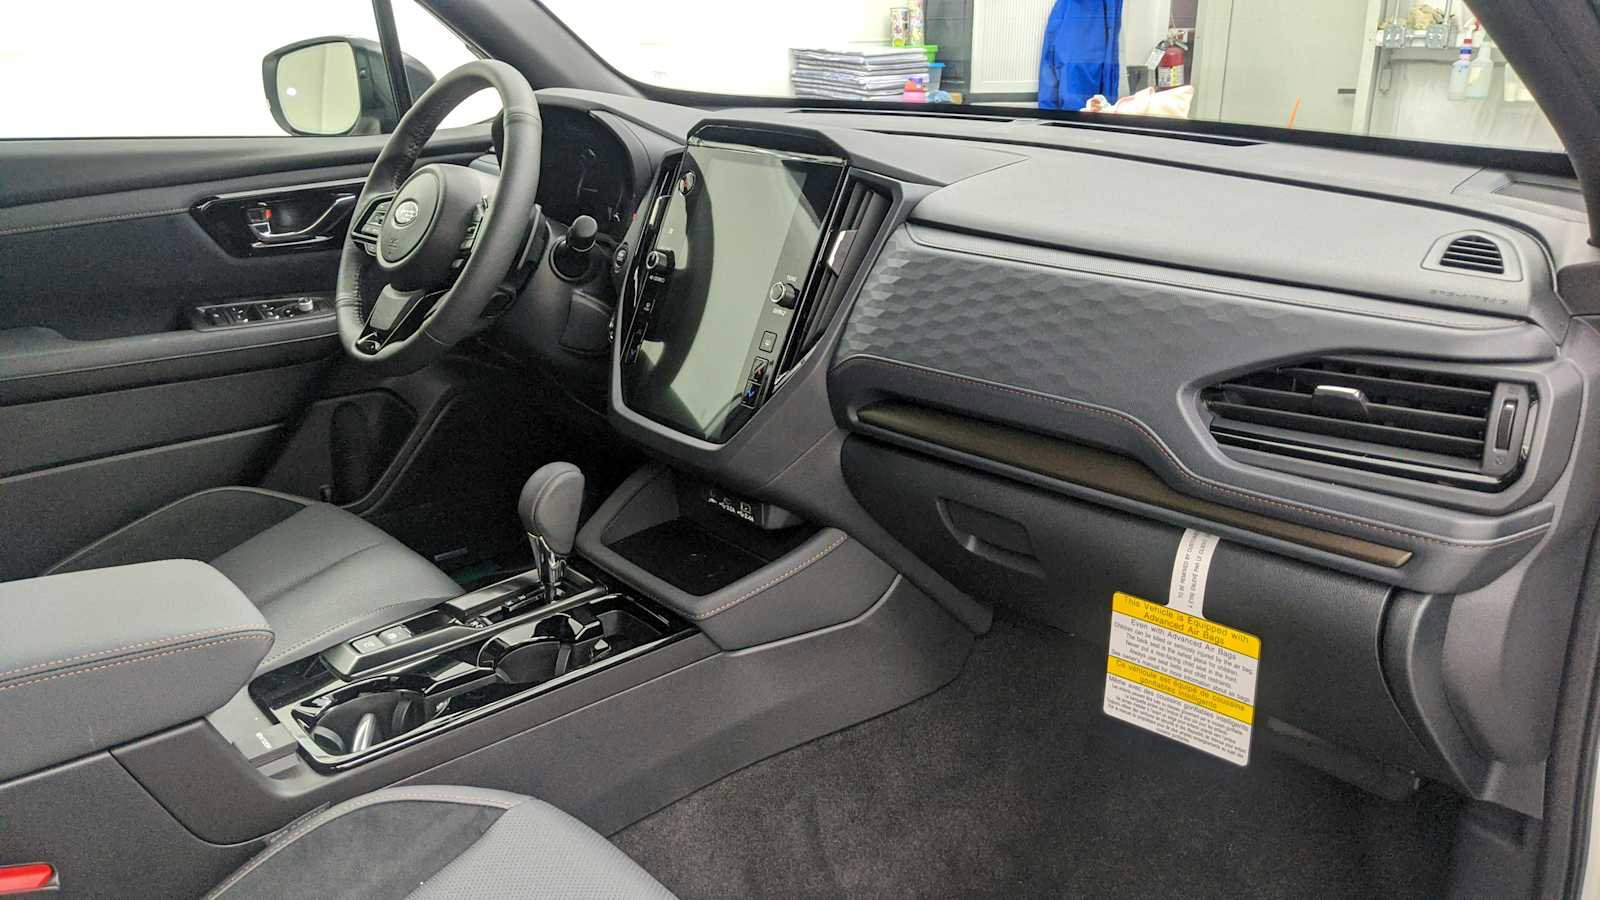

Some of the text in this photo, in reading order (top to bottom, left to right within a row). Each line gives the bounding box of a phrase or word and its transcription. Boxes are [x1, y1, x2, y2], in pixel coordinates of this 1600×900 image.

[1123, 595, 1140, 607] This
[1144, 603, 1173, 618] Vehicle
[1186, 616, 1227, 636] Equipped
[1231, 632, 1249, 643] with
[1143, 611, 1224, 646] Advanced Air Bags
[1130, 618, 1236, 660] Even with Advanced Air Bags
[1200, 688, 1209, 698] de
